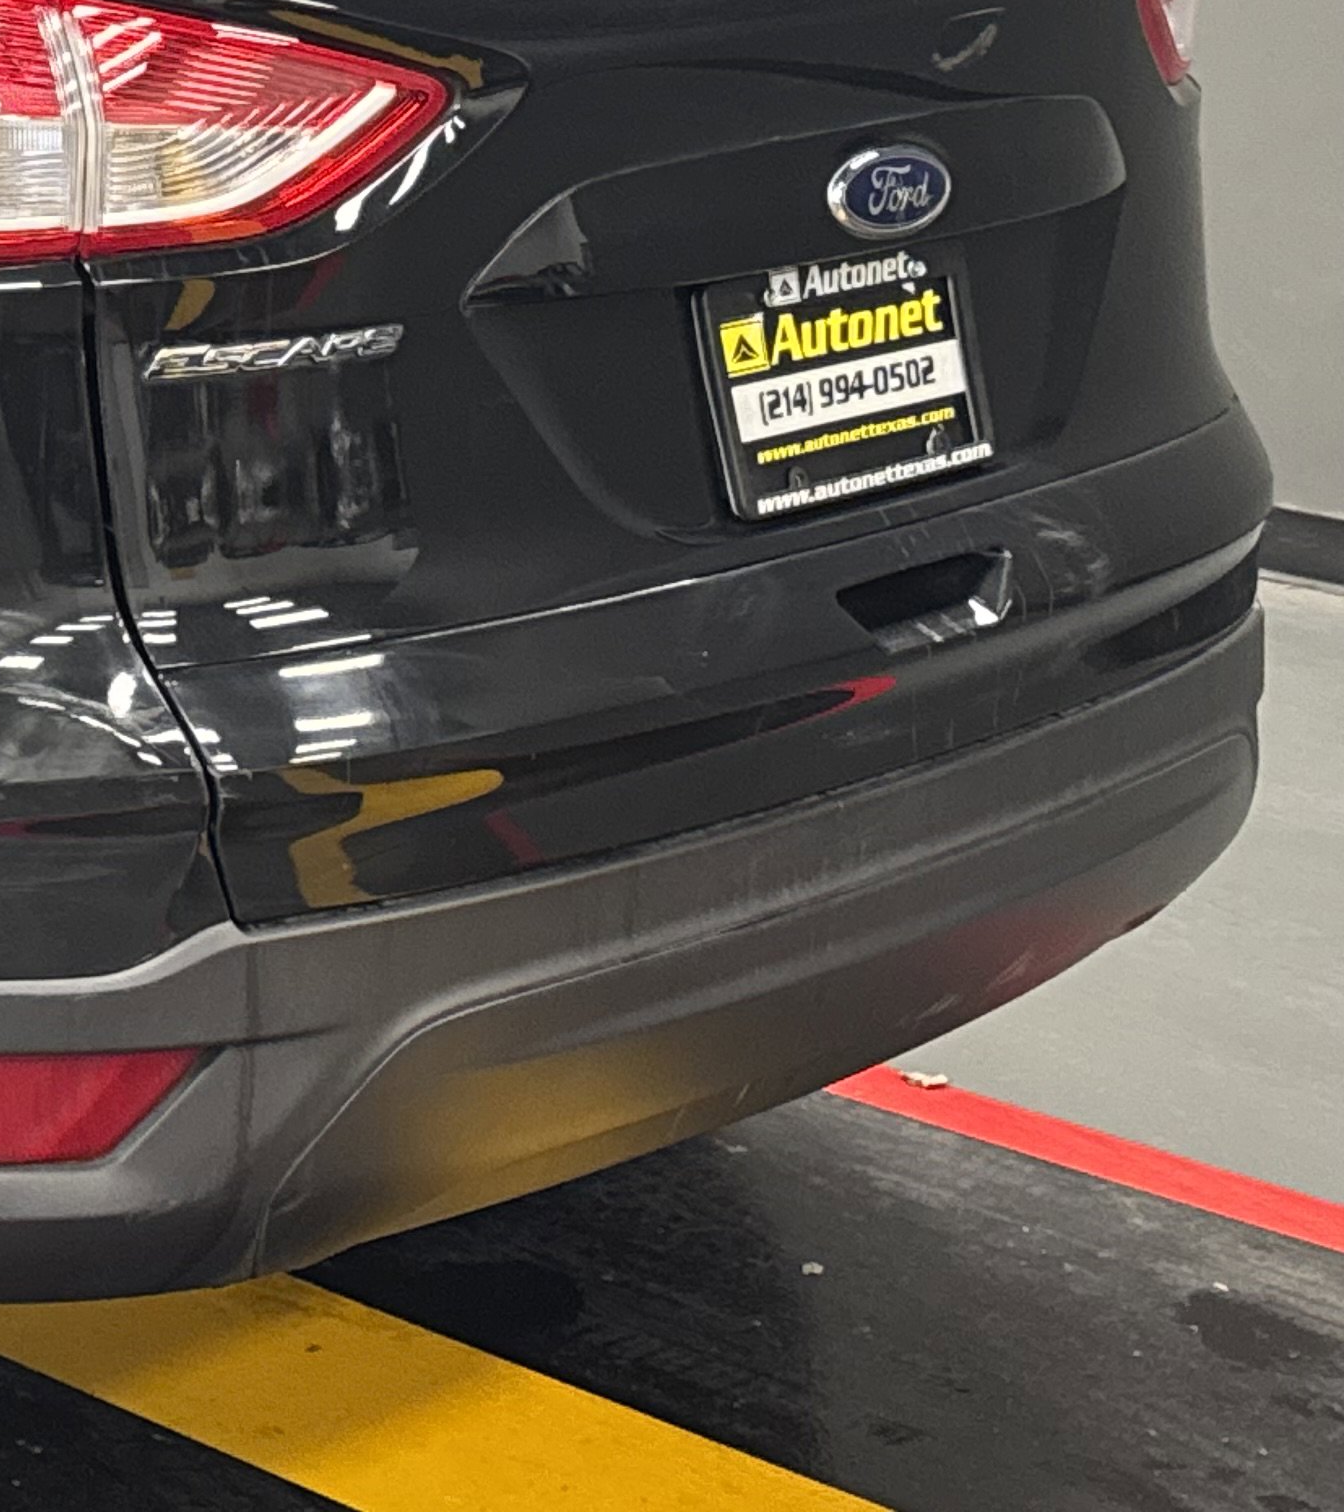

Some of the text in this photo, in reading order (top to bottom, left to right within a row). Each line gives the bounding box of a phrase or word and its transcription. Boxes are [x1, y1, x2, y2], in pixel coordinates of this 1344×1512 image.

[868, 164, 935, 216] Ford
[803, 251, 909, 299] Autonet
[141, 324, 404, 381] ESCAPE
[772, 288, 944, 366] Autonet
[760, 355, 937, 426] (214) 994-0502
[757, 406, 955, 464] www.autonettexas.com
[757, 442, 994, 515] www.autonettexas.com
